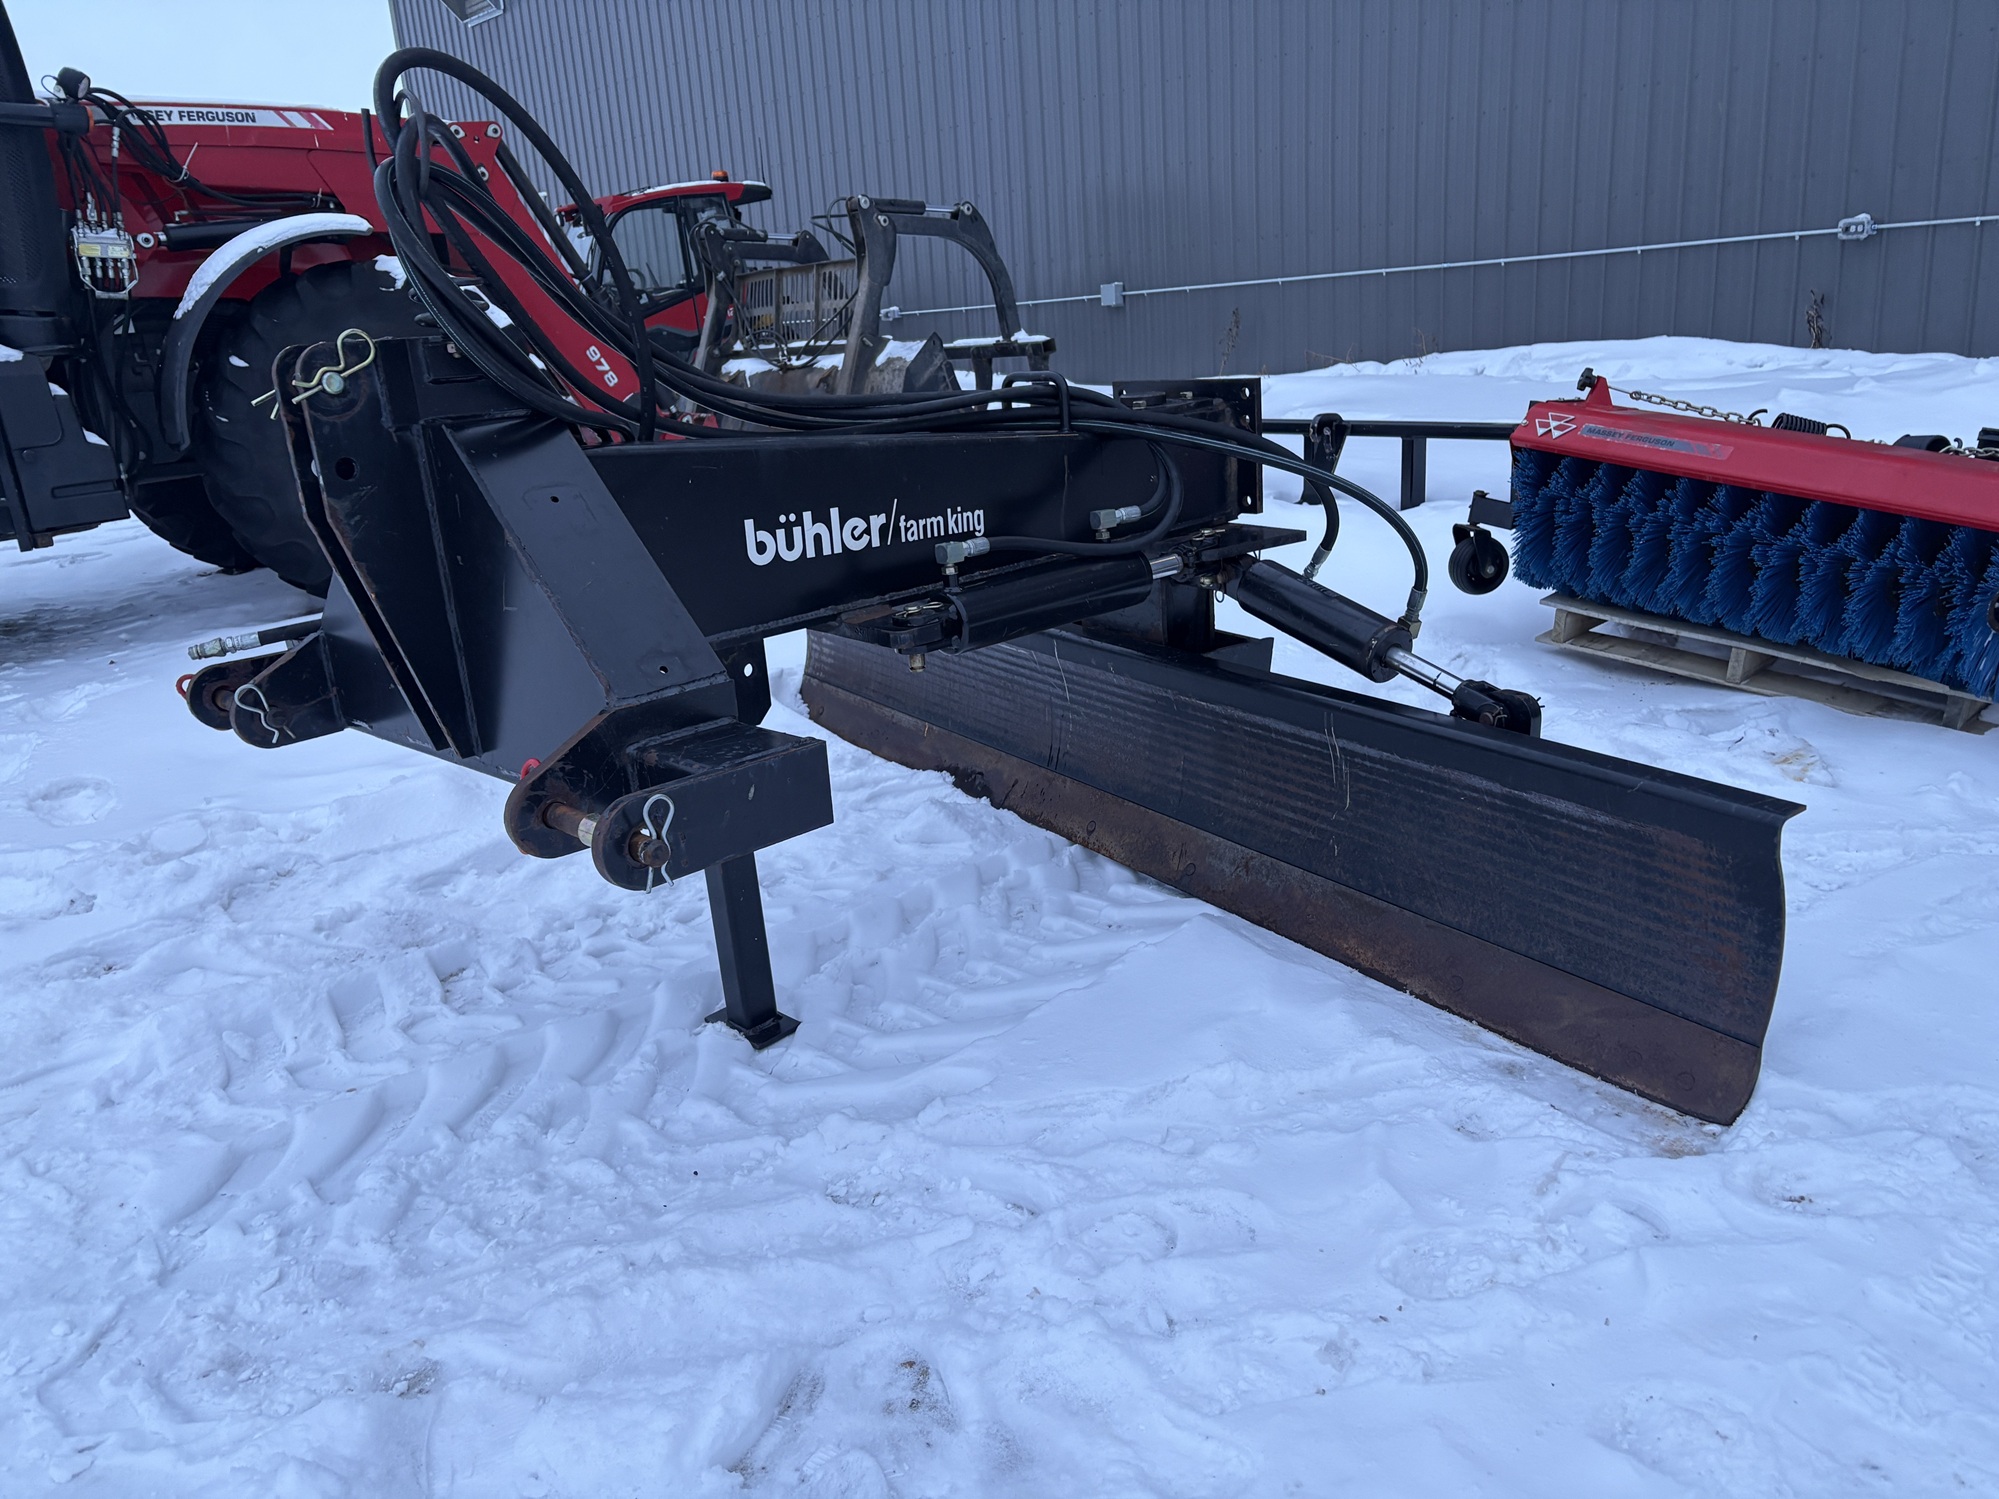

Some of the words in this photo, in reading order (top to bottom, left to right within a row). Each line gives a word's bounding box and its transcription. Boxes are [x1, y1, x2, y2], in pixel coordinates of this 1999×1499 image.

[179, 110, 257, 123] FERGUSON
[585, 345, 619, 388] 978
[1586, 427, 1624, 439] MASSEY
[1625, 433, 1676, 447] FERGUSON
[946, 506, 985, 537] king
